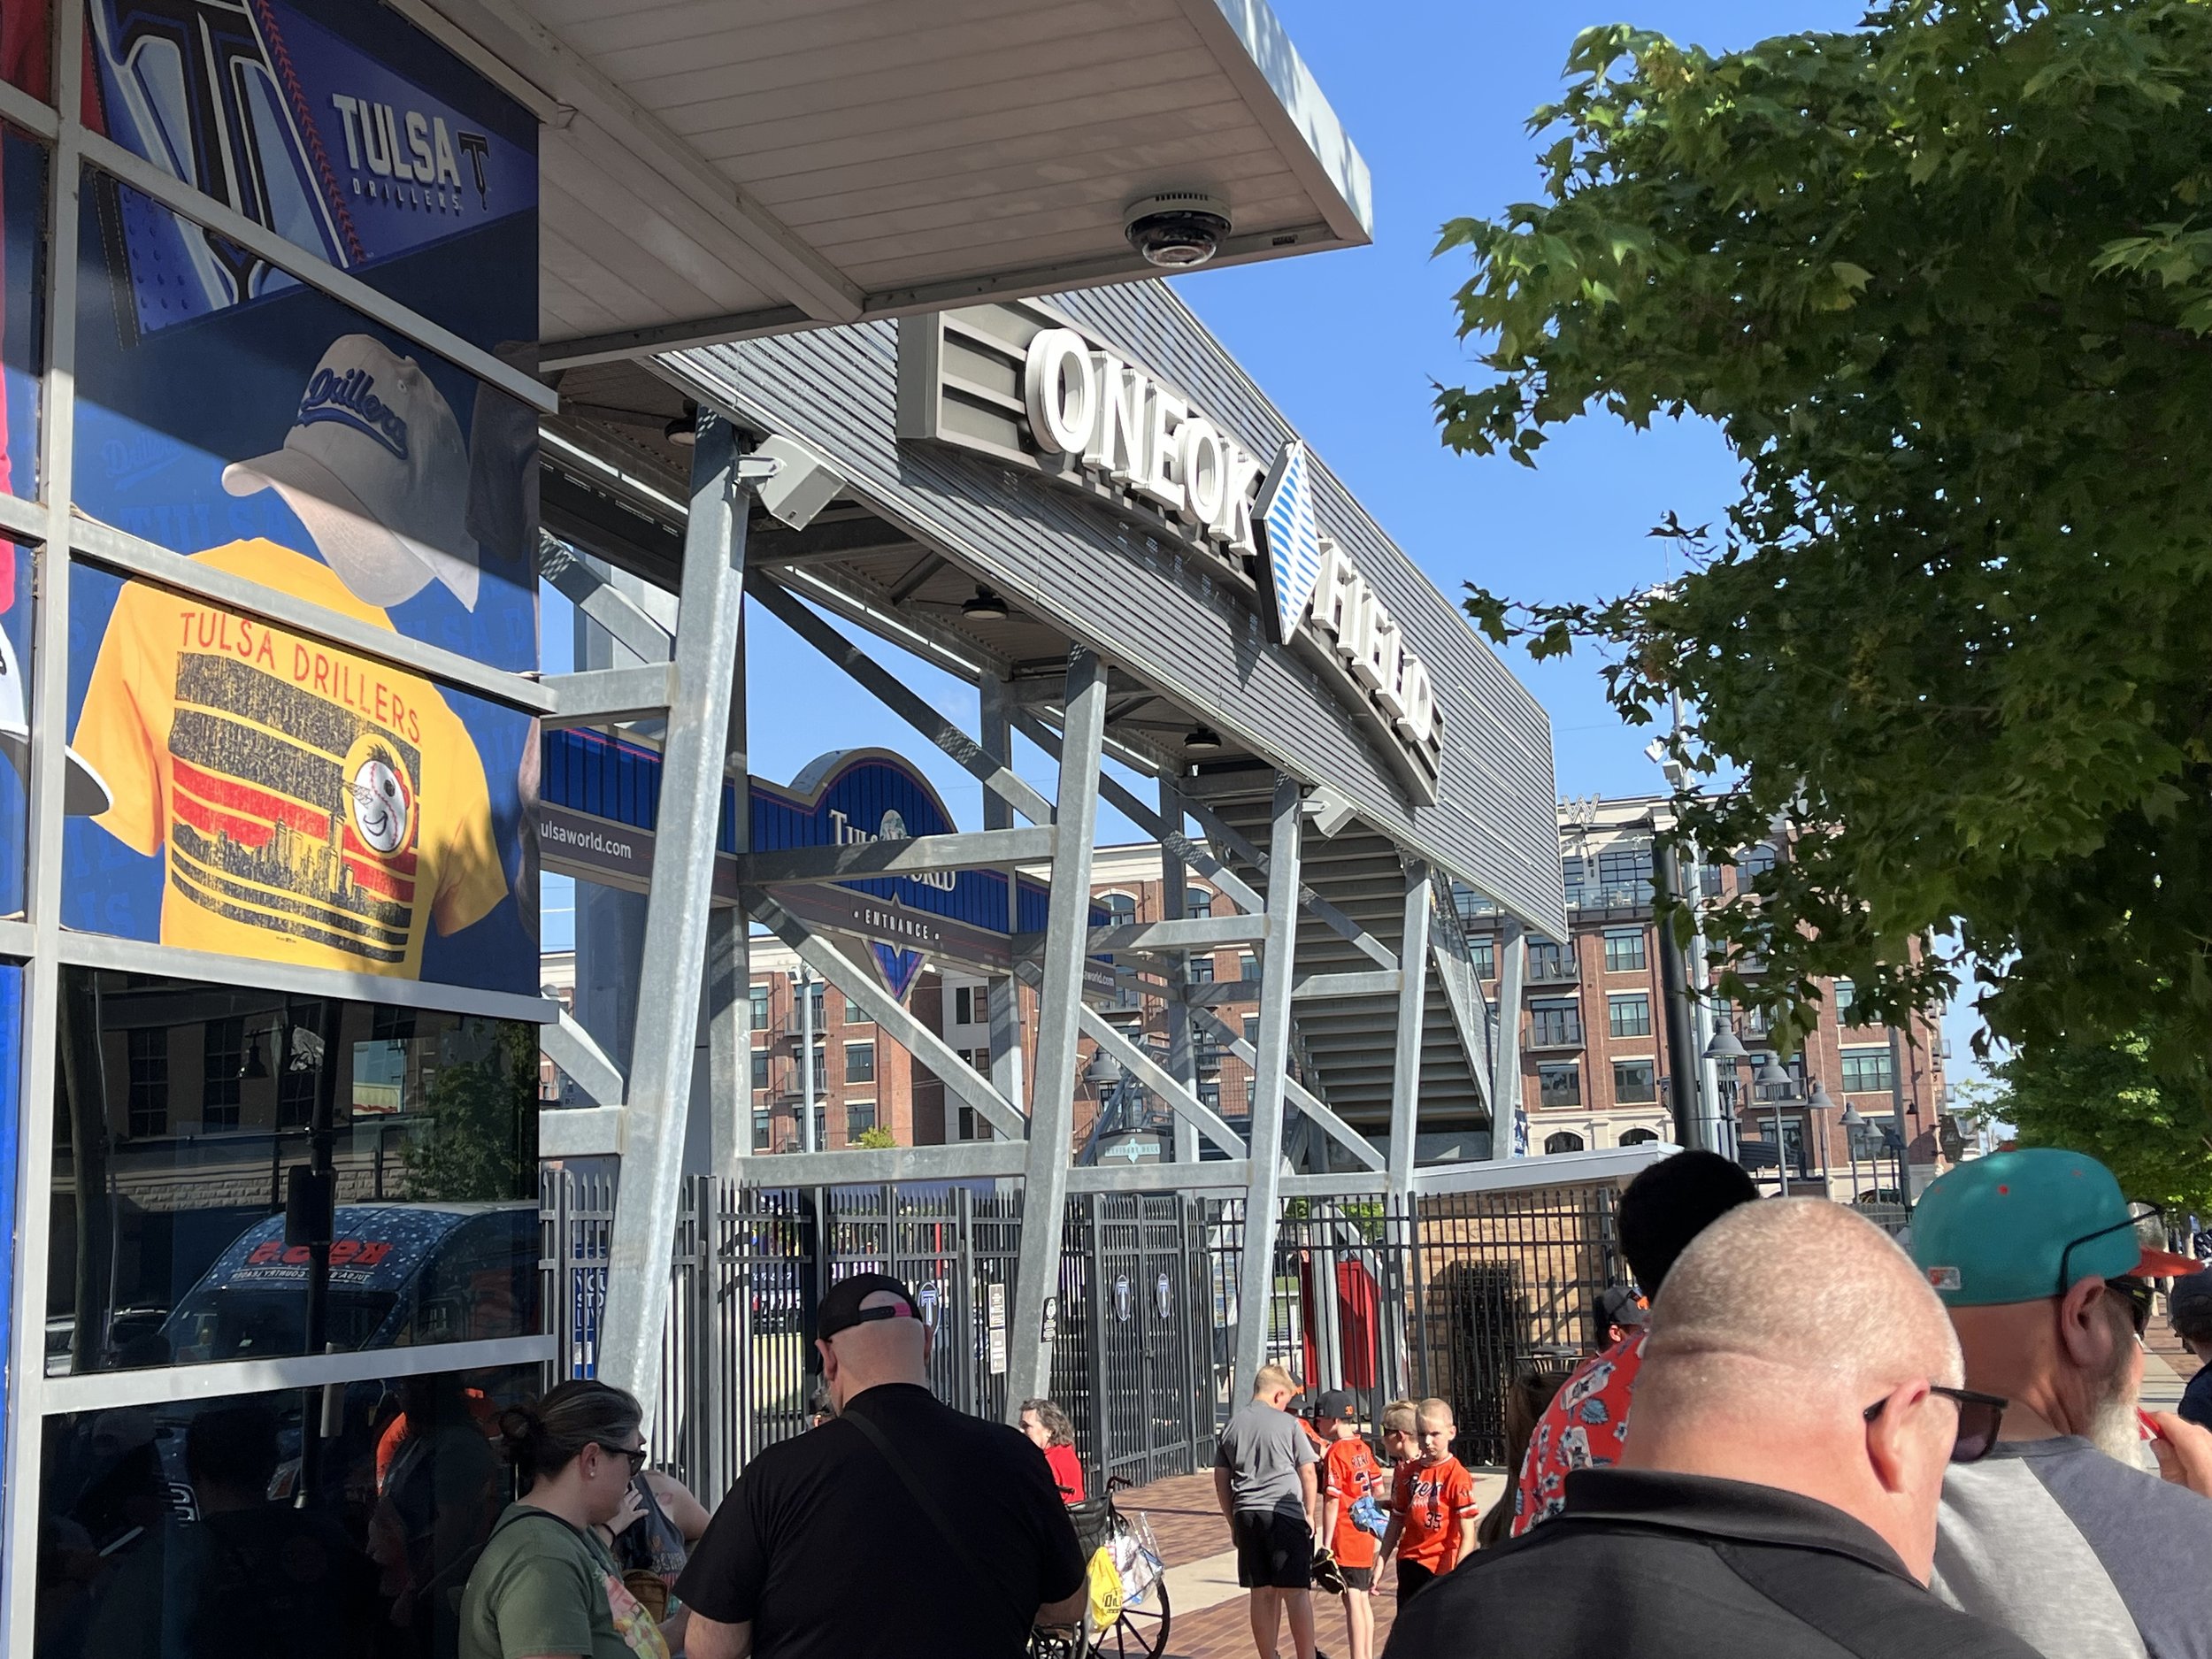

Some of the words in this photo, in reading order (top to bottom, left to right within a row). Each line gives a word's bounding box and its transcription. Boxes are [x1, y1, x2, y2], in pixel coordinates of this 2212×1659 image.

[332, 93, 462, 189] TULSA
[352, 177, 462, 211] DRILLERS
[300, 367, 408, 449] Drillers
[1025, 327, 1260, 557] ONEOK
[1310, 537, 1432, 742] FIELD
[180, 611, 276, 671] TULSA
[293, 642, 421, 744] DRILLERS
[541, 820, 632, 859] ulsaworld.com
[864, 908, 929, 941] ENTRANCE
